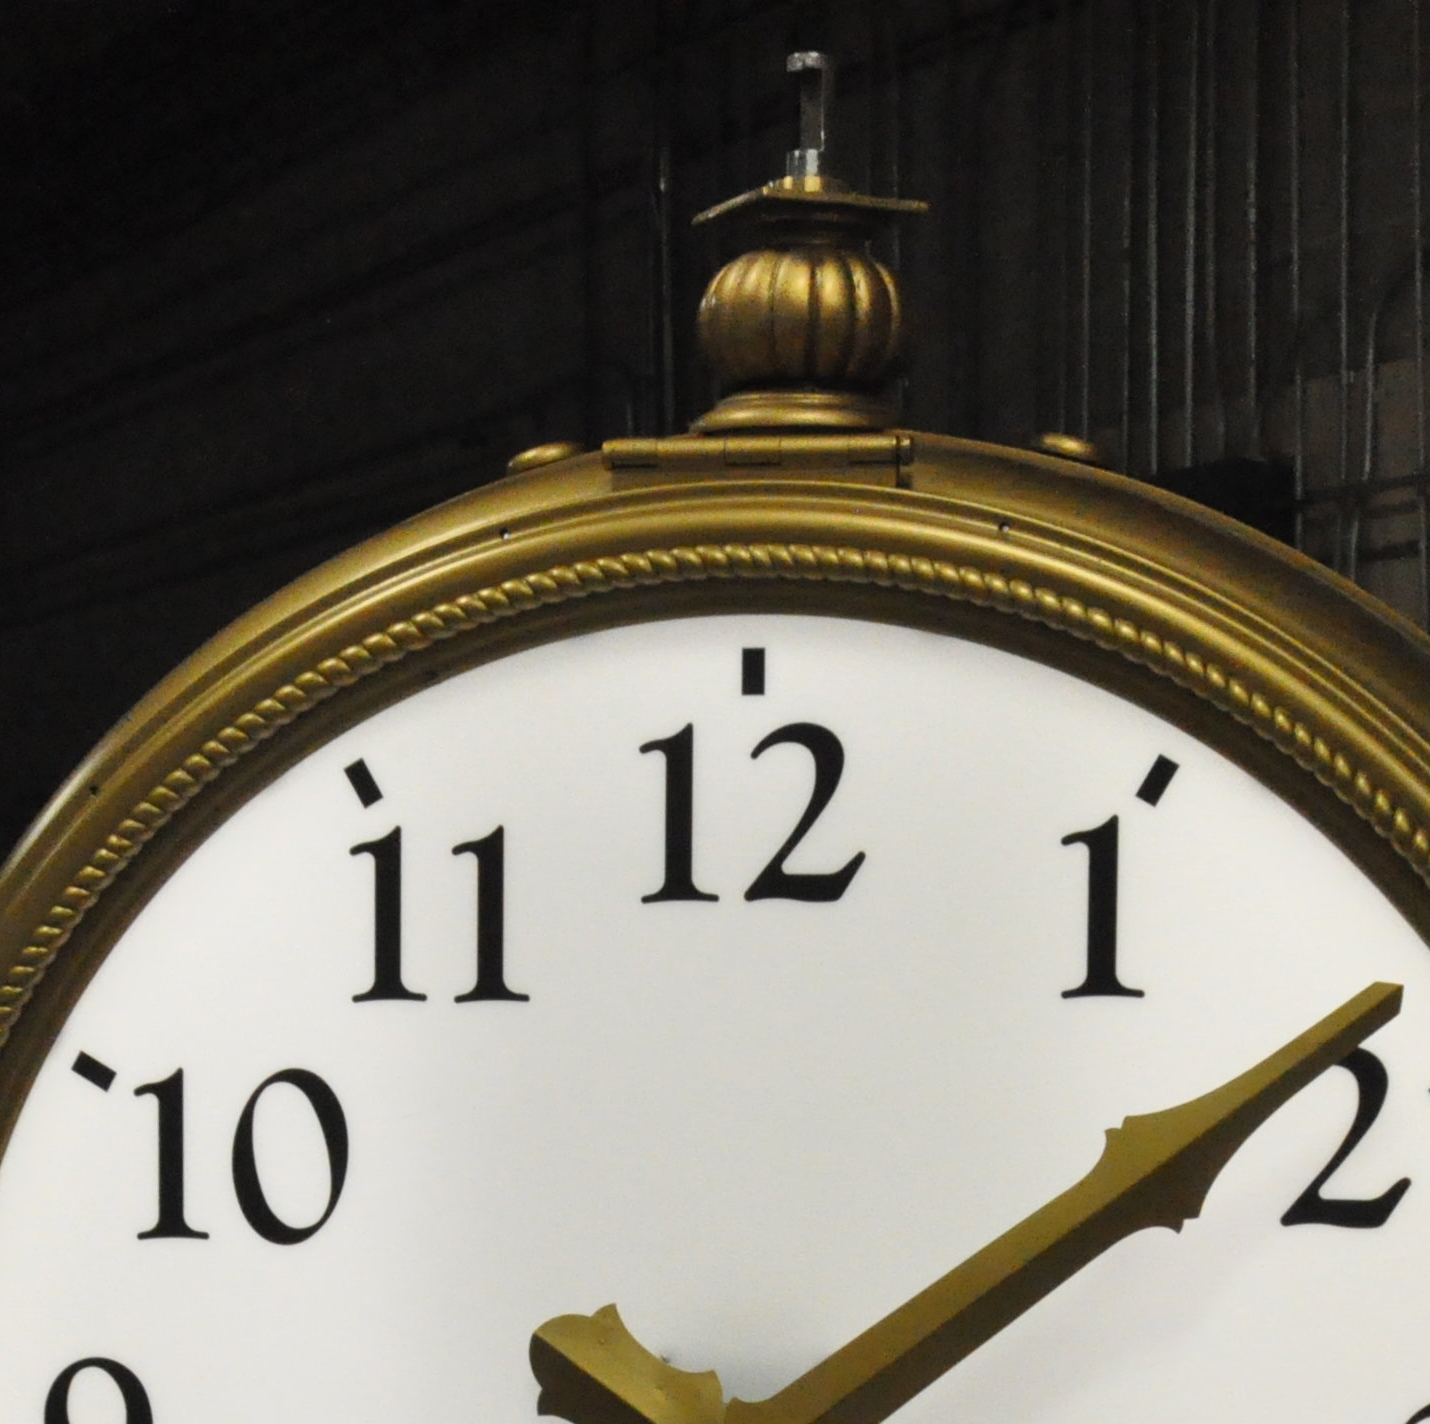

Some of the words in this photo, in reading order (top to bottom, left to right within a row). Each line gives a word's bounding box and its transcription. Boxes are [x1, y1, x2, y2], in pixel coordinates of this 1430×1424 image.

[639, 722, 866, 904] 12
[349, 825, 530, 1004] 11
[1060, 814, 1145, 1000] 1
[133, 1067, 349, 1246] 10
[1279, 1045, 1413, 1230] 2
